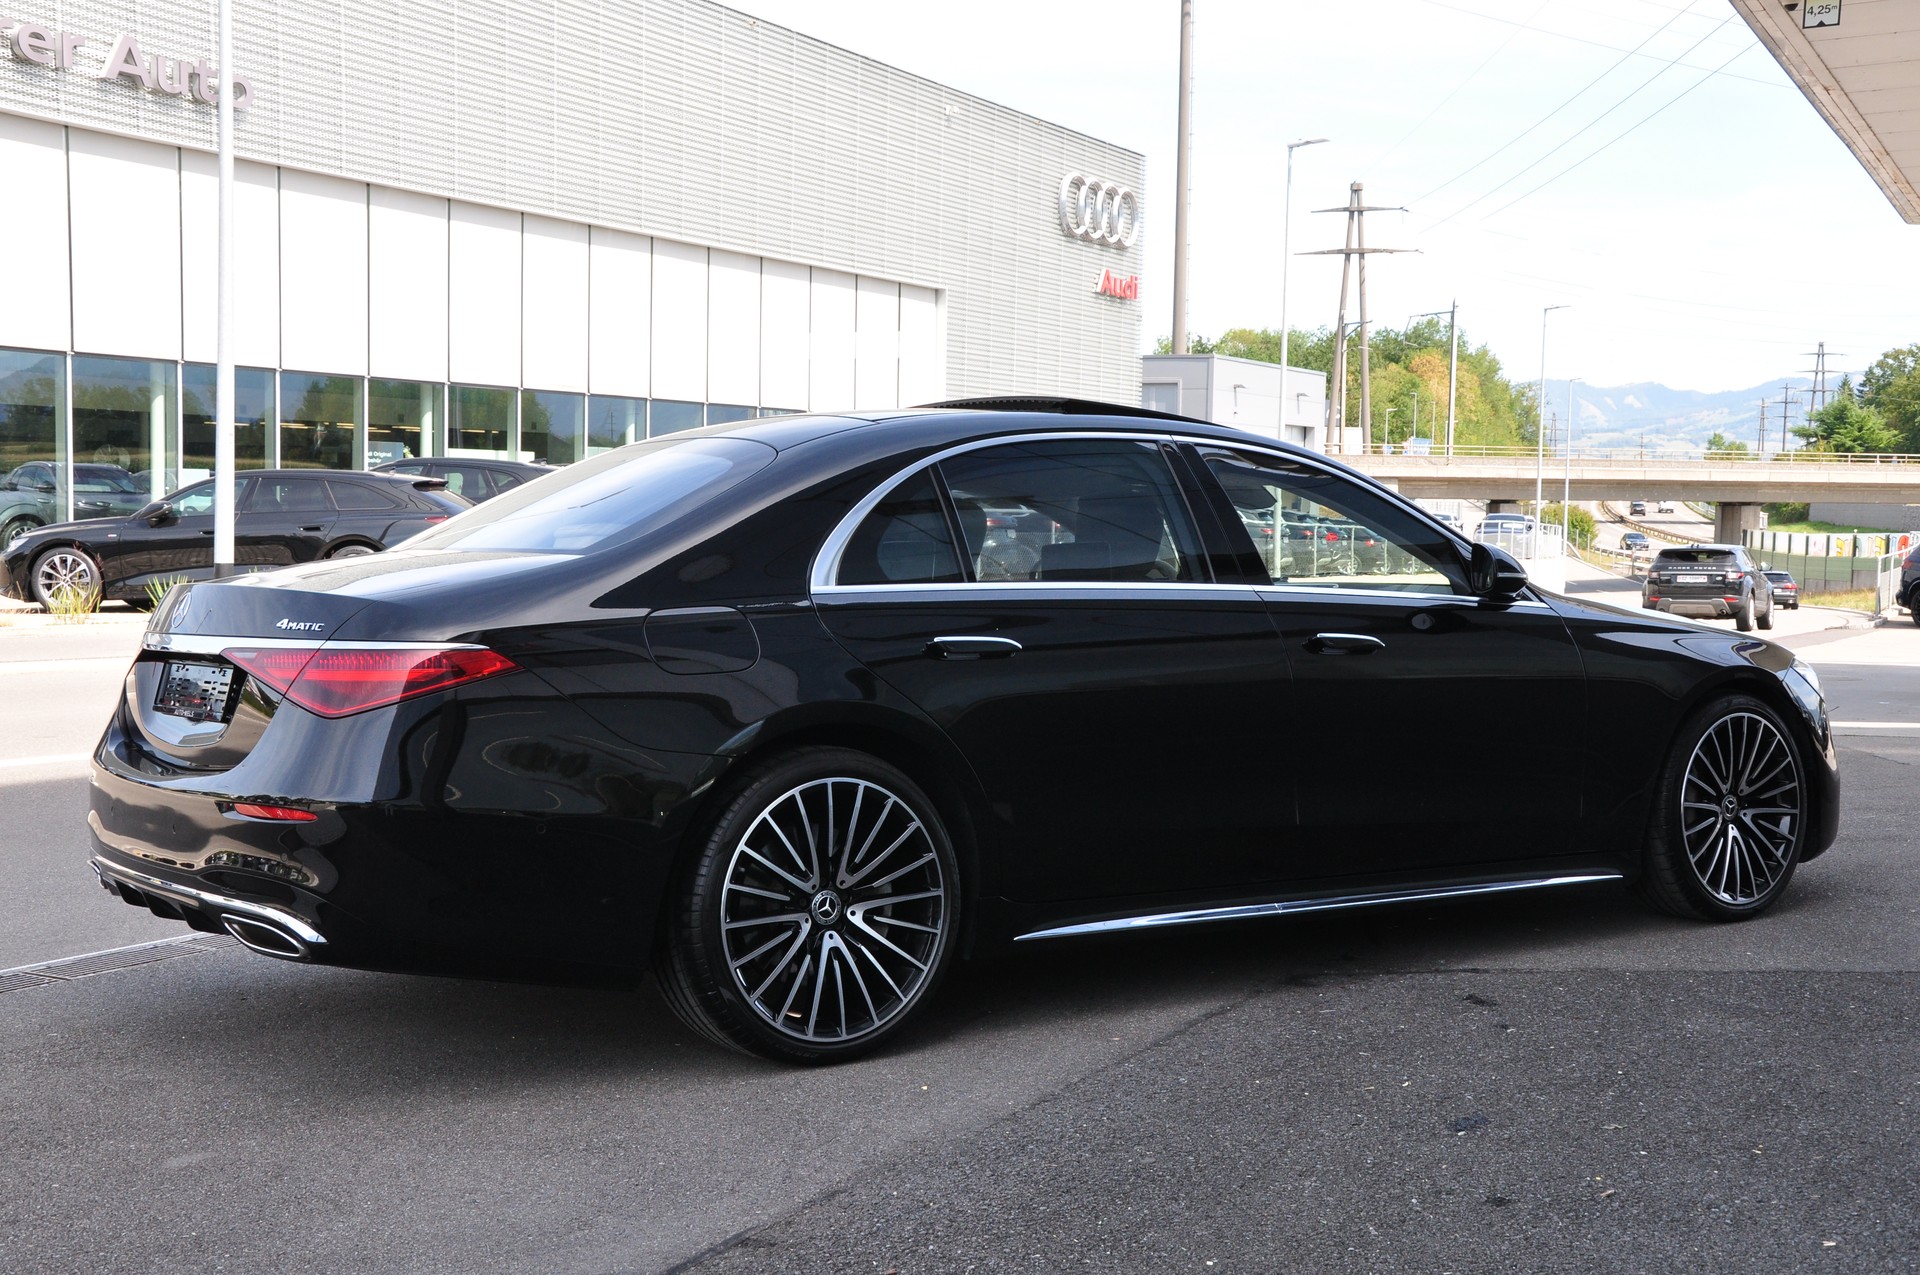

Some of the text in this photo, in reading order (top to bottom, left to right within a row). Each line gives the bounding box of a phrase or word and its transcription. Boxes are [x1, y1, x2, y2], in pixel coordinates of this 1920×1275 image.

[101, 35, 256, 109] Auto
[1098, 268, 1138, 300] Audi
[275, 618, 325, 631] 4MATIC
